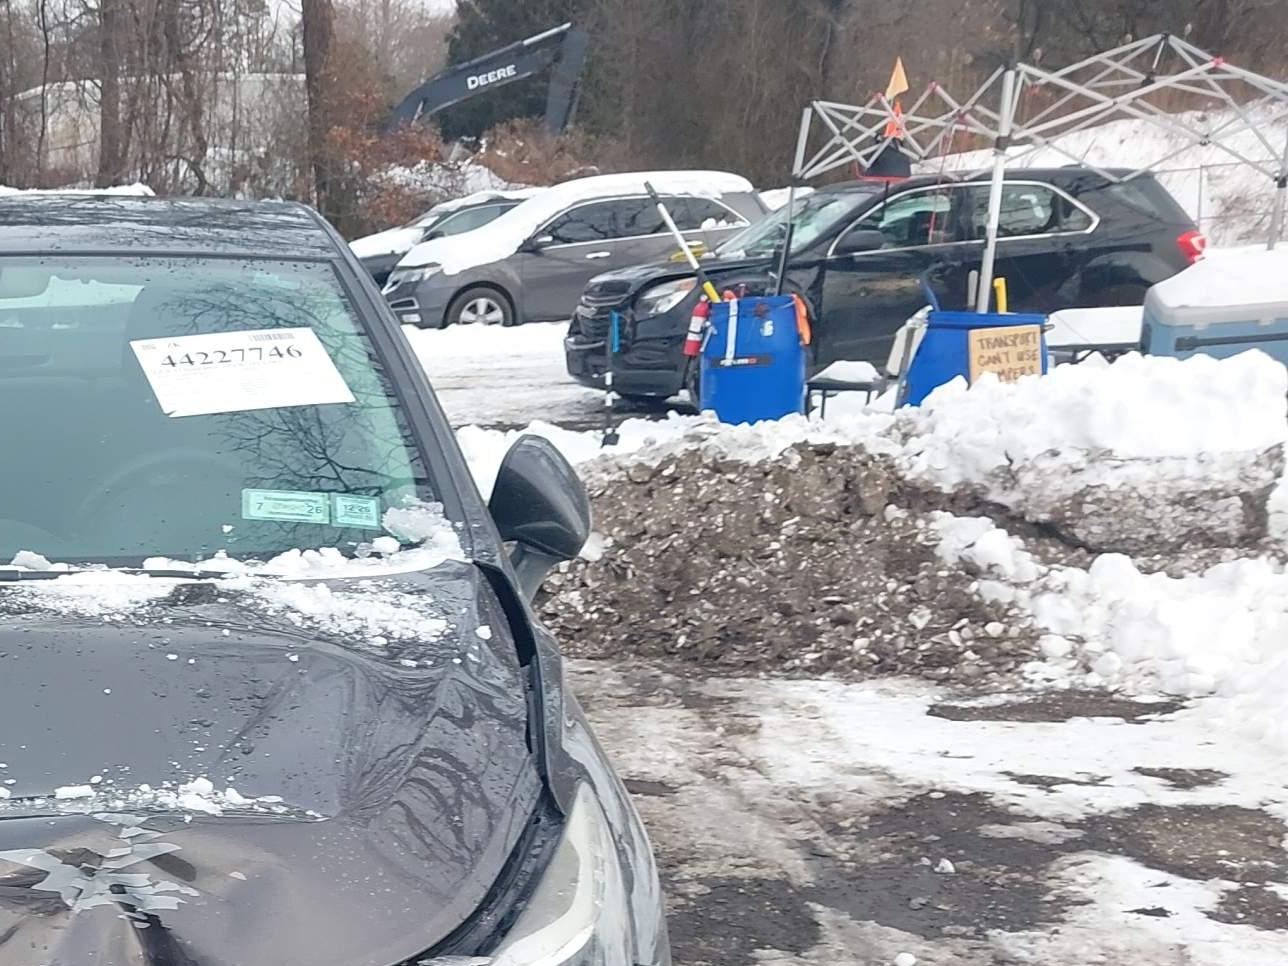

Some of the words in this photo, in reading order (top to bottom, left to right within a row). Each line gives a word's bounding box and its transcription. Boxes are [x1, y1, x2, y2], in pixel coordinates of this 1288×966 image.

[466, 64, 517, 90] DEERE
[977, 331, 1037, 350] TRANSPORT
[160, 344, 303, 368] 44227746
[1017, 348, 1039, 362] USE
[307, 505, 322, 514] 26
